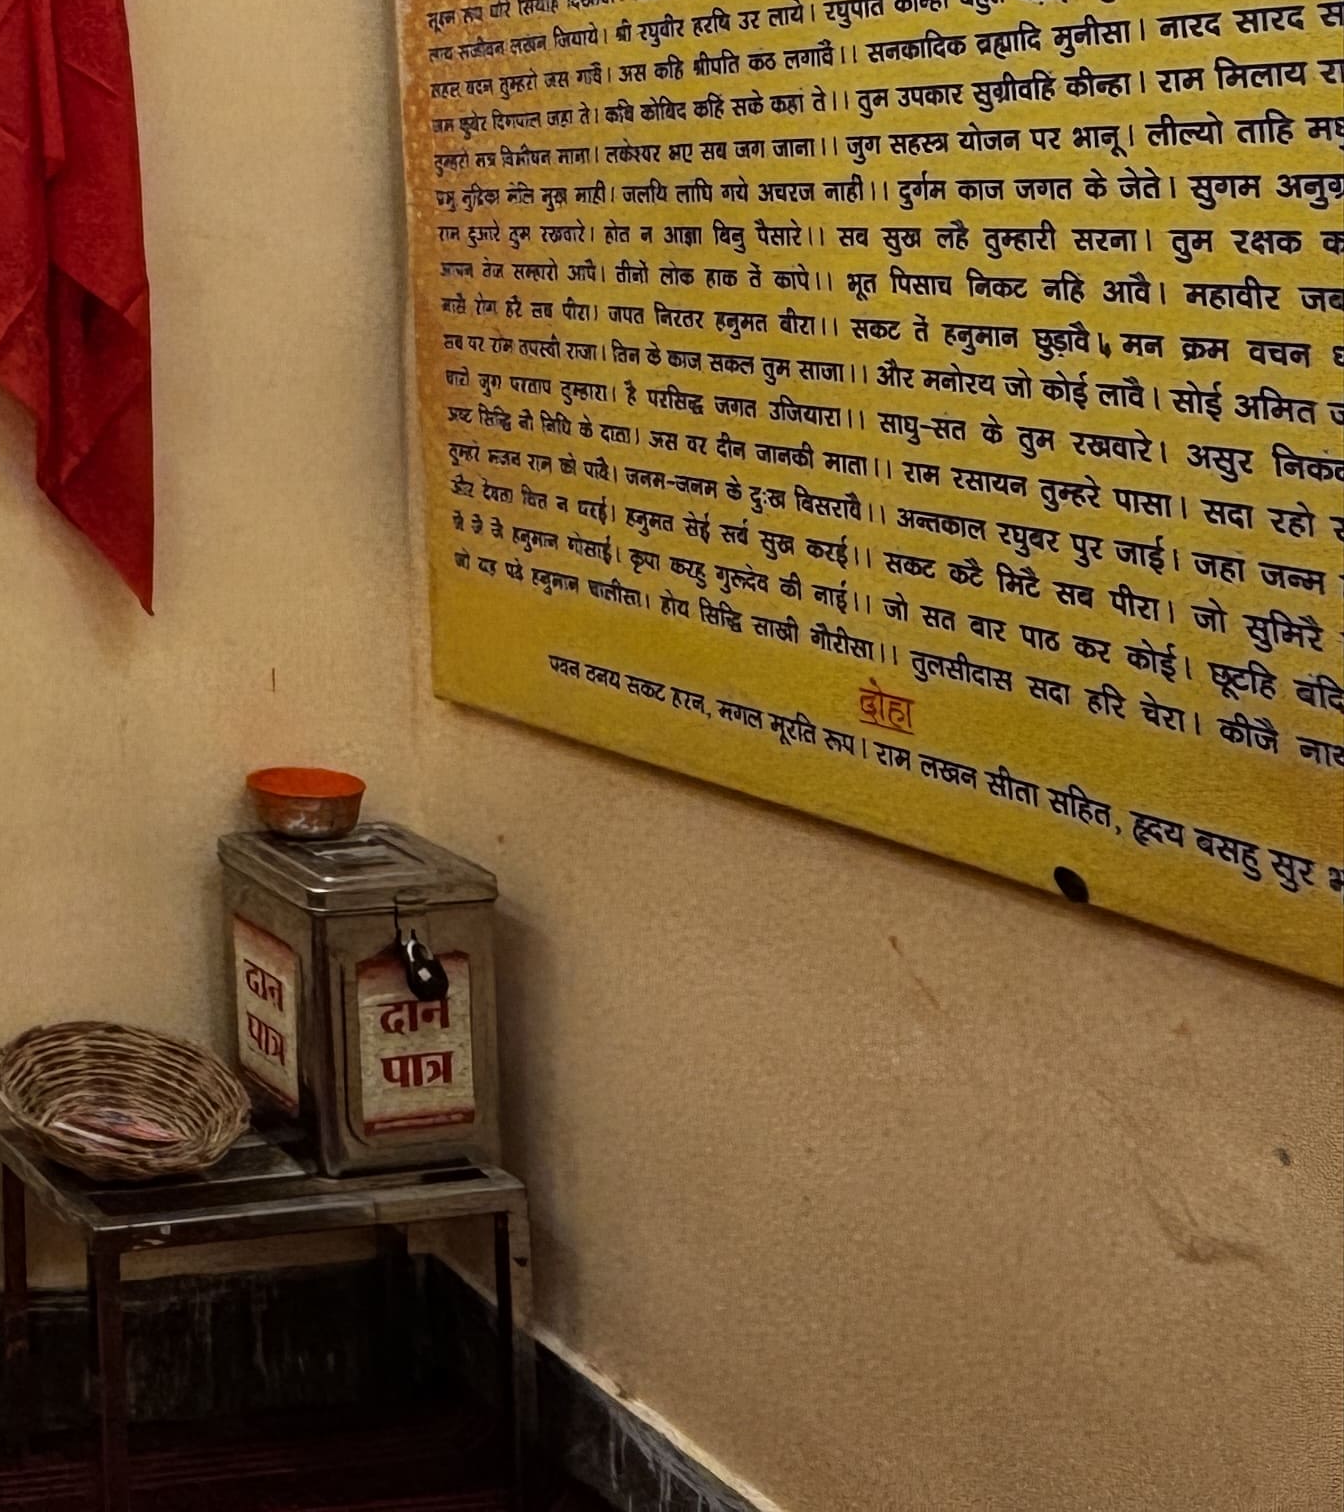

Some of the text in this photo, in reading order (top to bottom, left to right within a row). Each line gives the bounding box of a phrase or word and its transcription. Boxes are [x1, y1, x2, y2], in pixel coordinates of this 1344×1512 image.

[1155, 4, 1306, 39] नारद सारद
[844, 107, 1296, 166] जुग पर ताहि
[954, 167, 1262, 210] काज जगत के सुगम
[879, 227, 922, 257] सुख
[1229, 229, 1303, 255] रक्षक
[1199, 498, 1316, 538] सदा रहो
[1018, 623, 1112, 665] पाठ कर
[856, 671, 912, 729] दोहा
[872, 740, 911, 772] राम
[917, 753, 978, 790] लखन
[983, 764, 1041, 808] सीता
[1266, 848, 1317, 894] सुर
[244, 959, 284, 1012] दान
[377, 999, 450, 1035] दान
[246, 1011, 287, 1066] पात्र
[380, 1051, 453, 1088] पात्र
